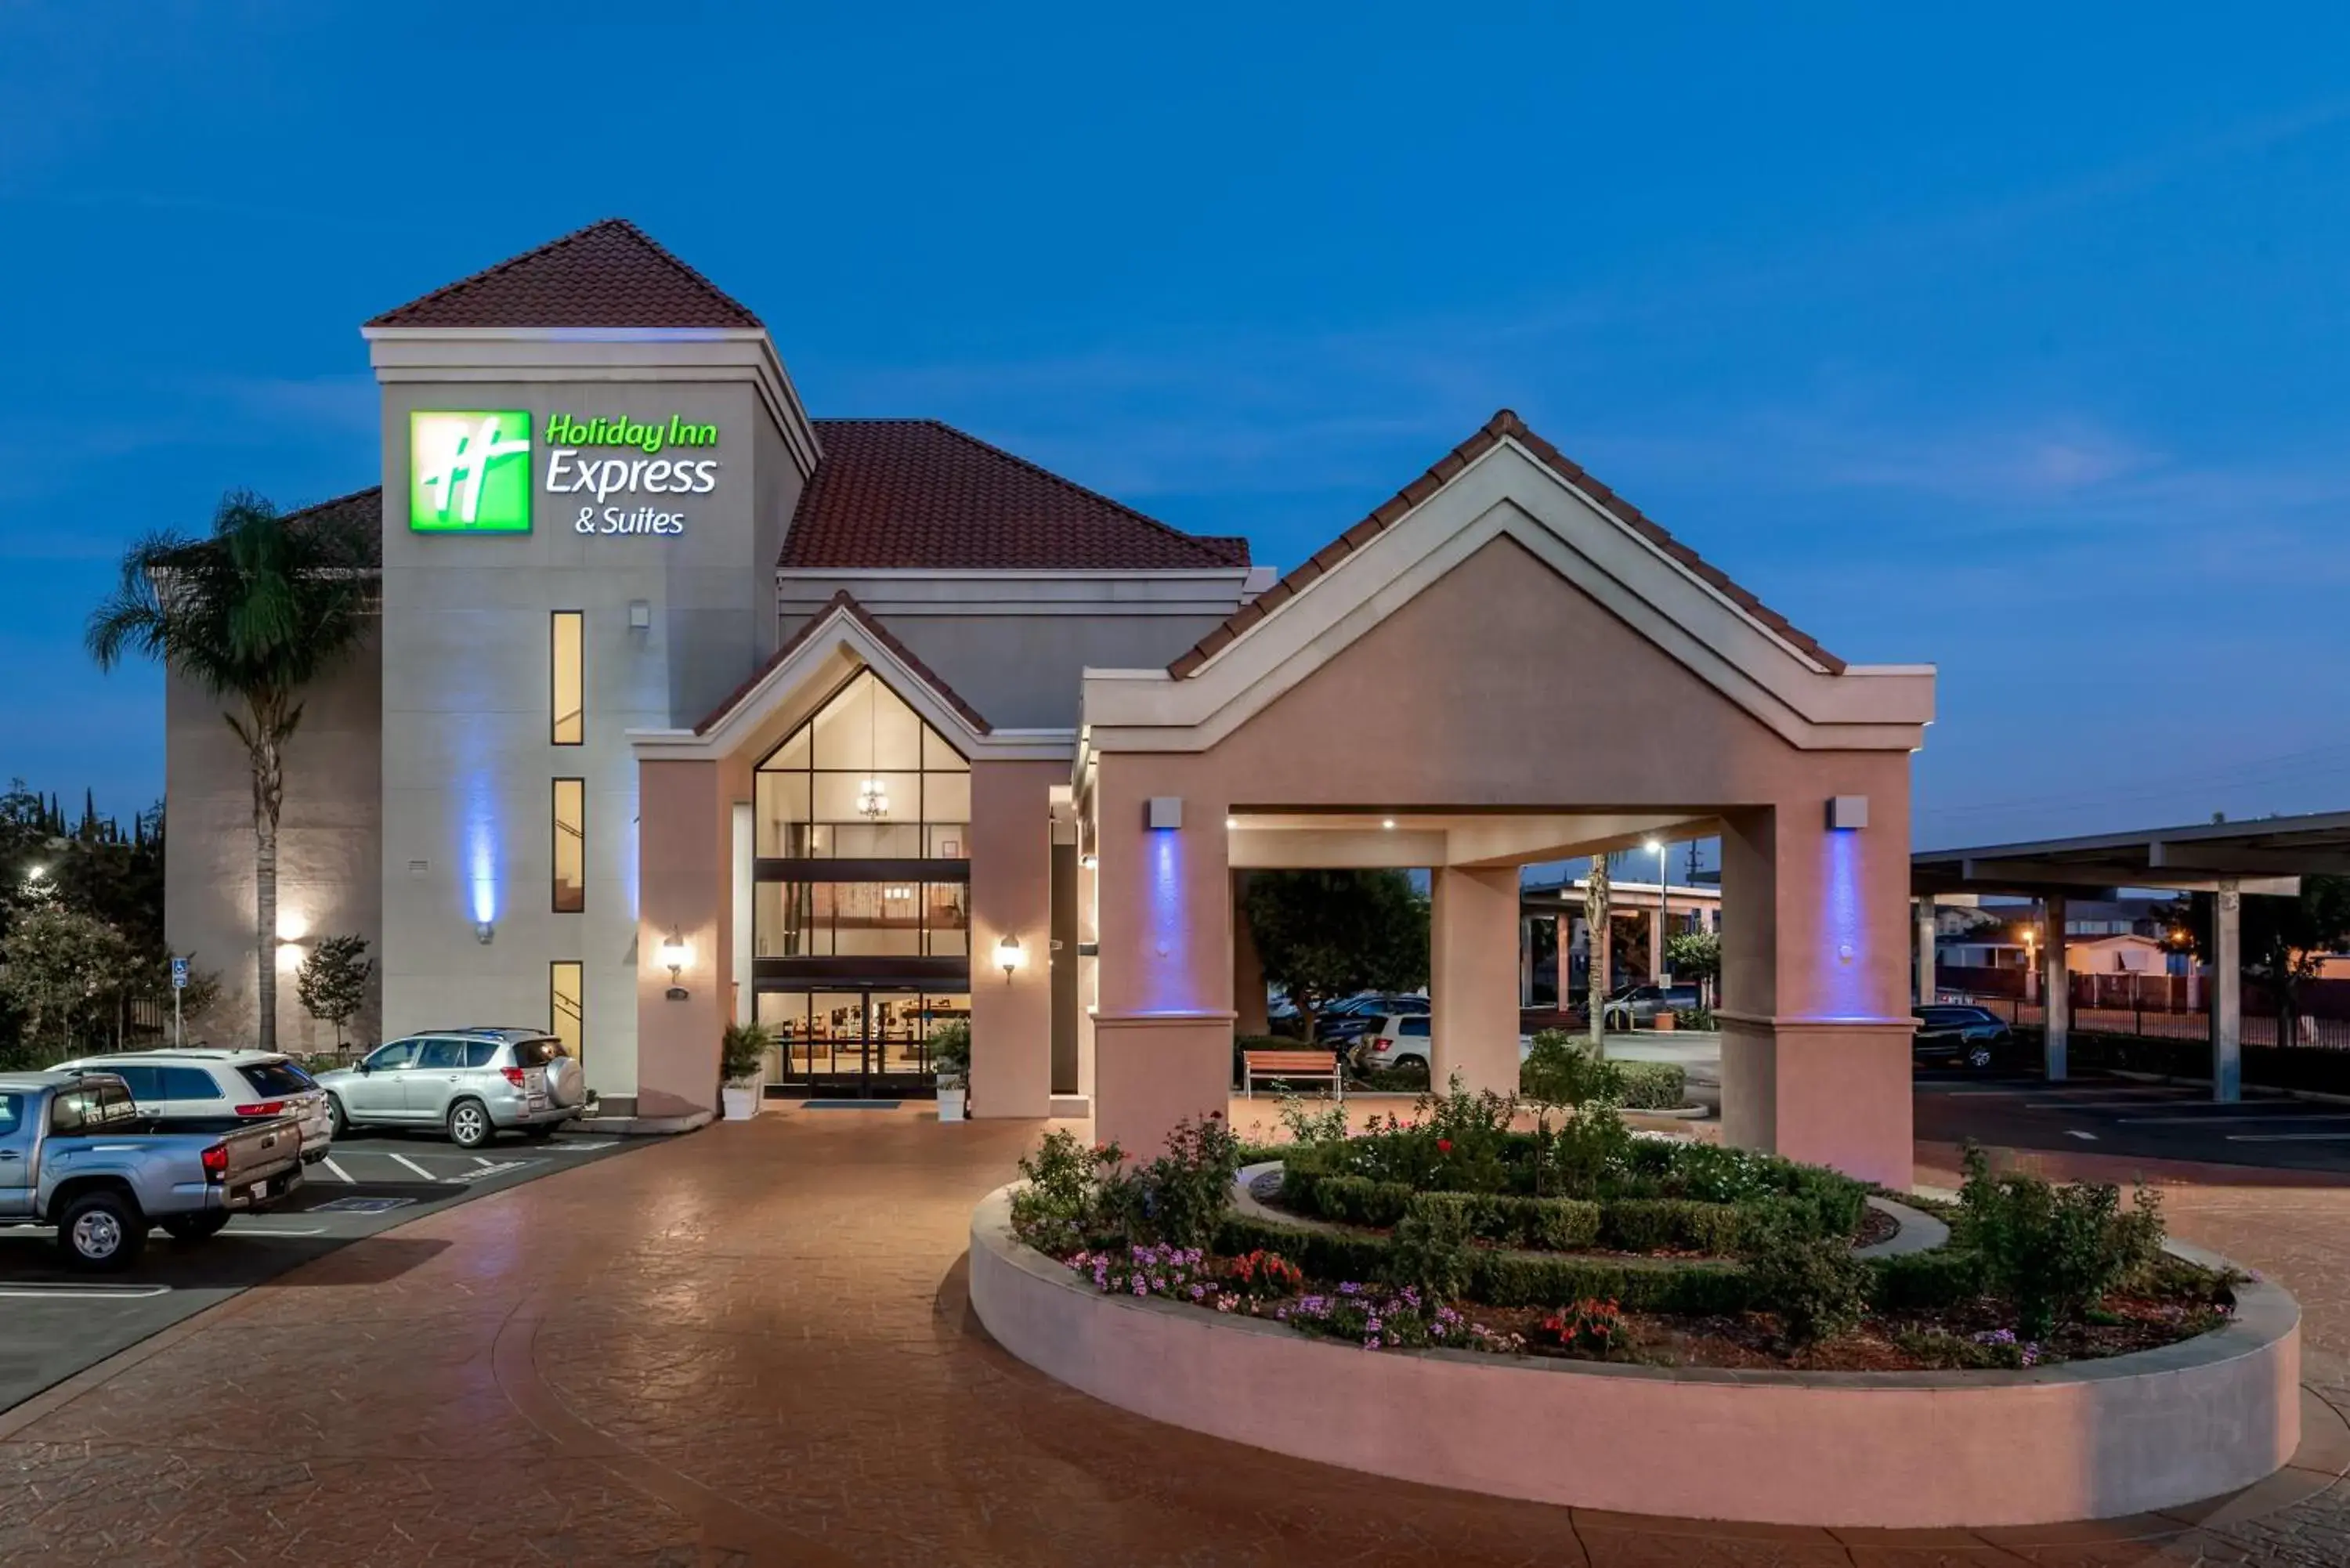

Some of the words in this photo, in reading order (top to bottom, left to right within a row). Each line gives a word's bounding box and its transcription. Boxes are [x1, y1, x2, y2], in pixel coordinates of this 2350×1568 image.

[546, 414, 664, 452] Holiday
[668, 414, 718, 446] Inn
[546, 449, 718, 504] Express
[575, 507, 595, 533] &
[600, 507, 684, 533] Suites
